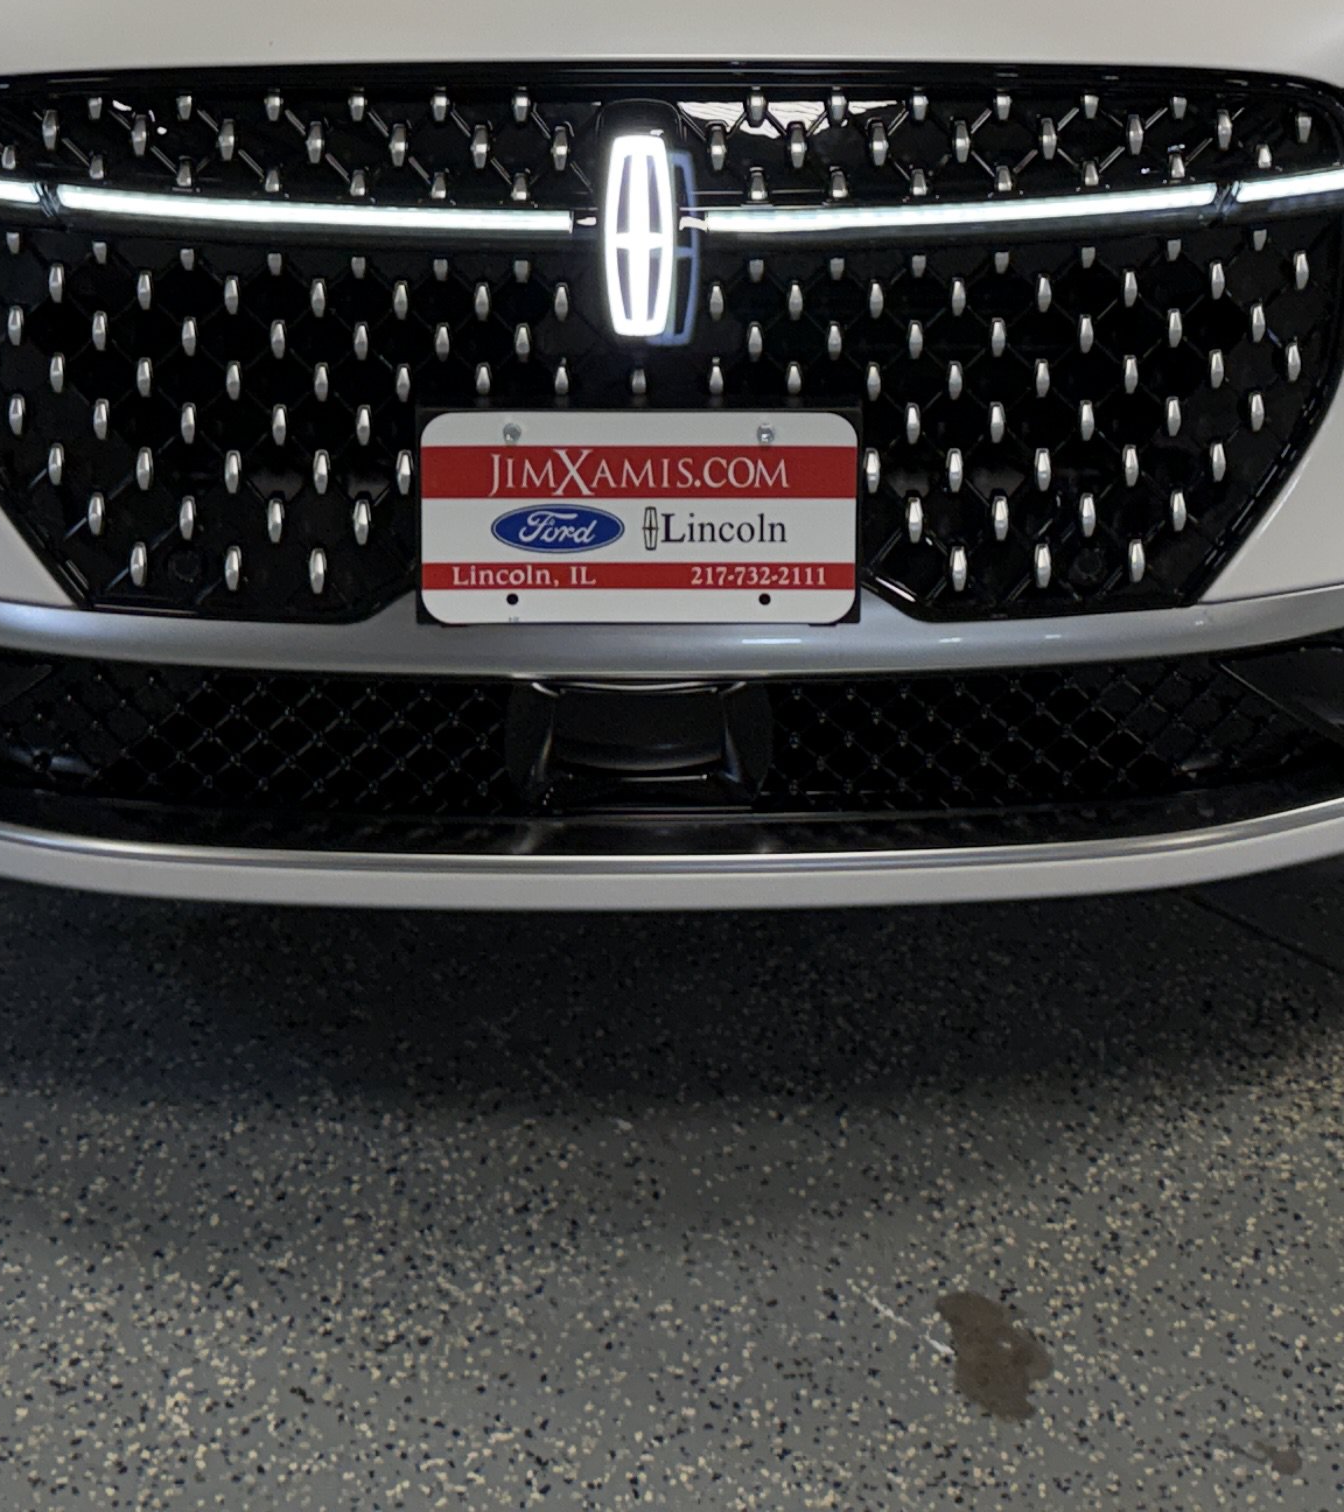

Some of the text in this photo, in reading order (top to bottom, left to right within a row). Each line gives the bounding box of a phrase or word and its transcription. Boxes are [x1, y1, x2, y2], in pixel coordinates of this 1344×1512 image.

[489, 448, 790, 497] JIMXAMIS.COM
[518, 510, 597, 544] Ford
[660, 511, 788, 544] Lincoln
[452, 564, 597, 588] Lincoln, IL
[690, 566, 827, 586] 217-732-2111
